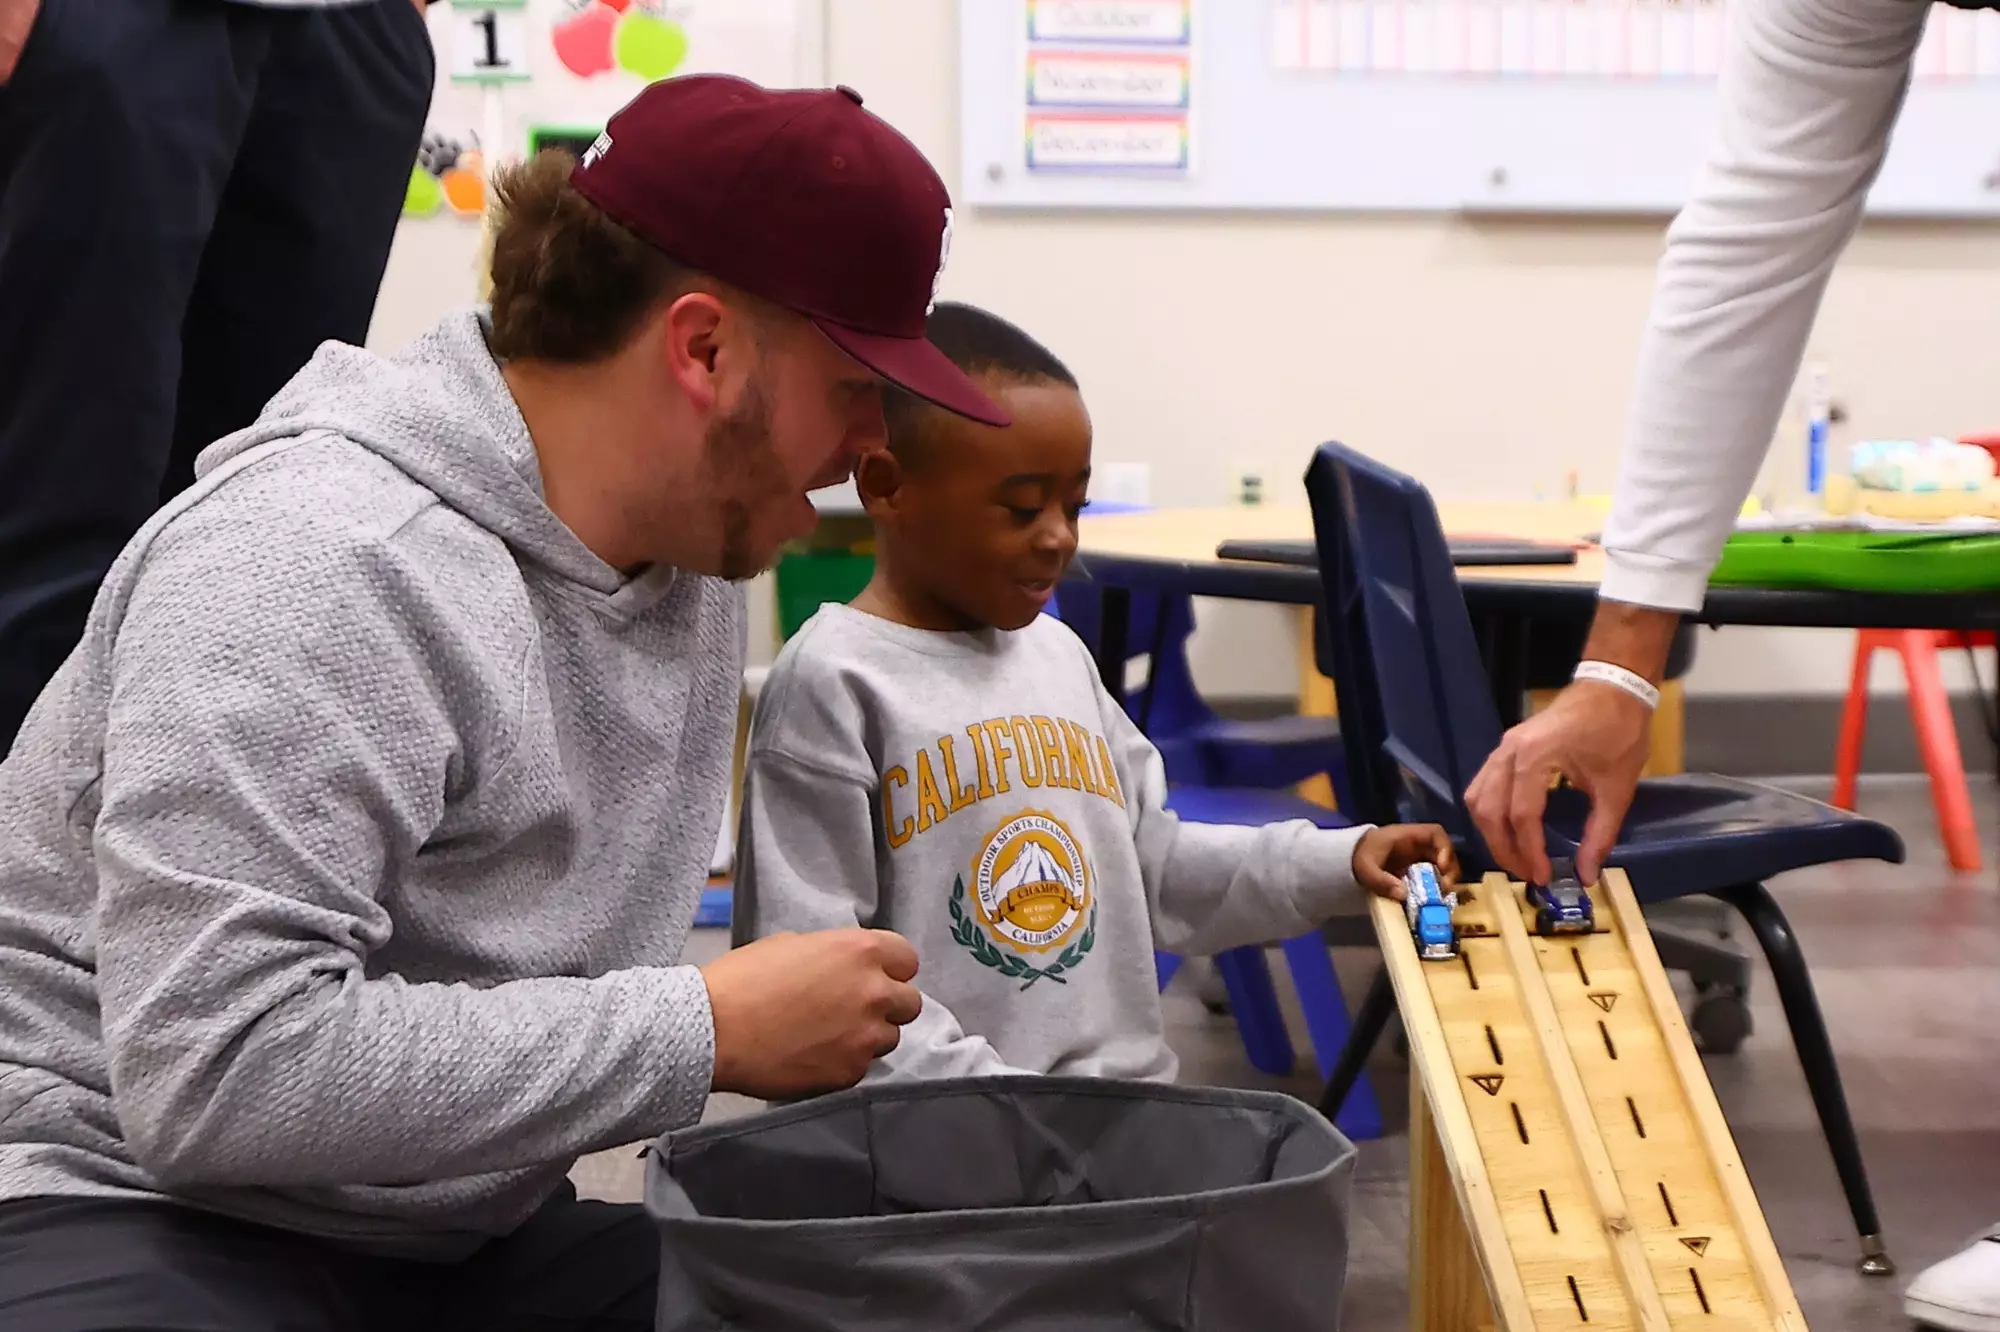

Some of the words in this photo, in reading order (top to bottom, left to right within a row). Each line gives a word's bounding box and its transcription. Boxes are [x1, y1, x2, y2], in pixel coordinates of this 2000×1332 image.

[473, 10, 510, 67] 1
[883, 715, 1125, 849] CALIFORNIA
[979, 845, 999, 902] OUTDOOR
[997, 818, 1033, 845] SPORTS
[1034, 818, 1083, 887] CHAMPIONSHIP
[1017, 883, 1060, 899] CHAMPS
[1012, 922, 1069, 943] CALIFORNIA
